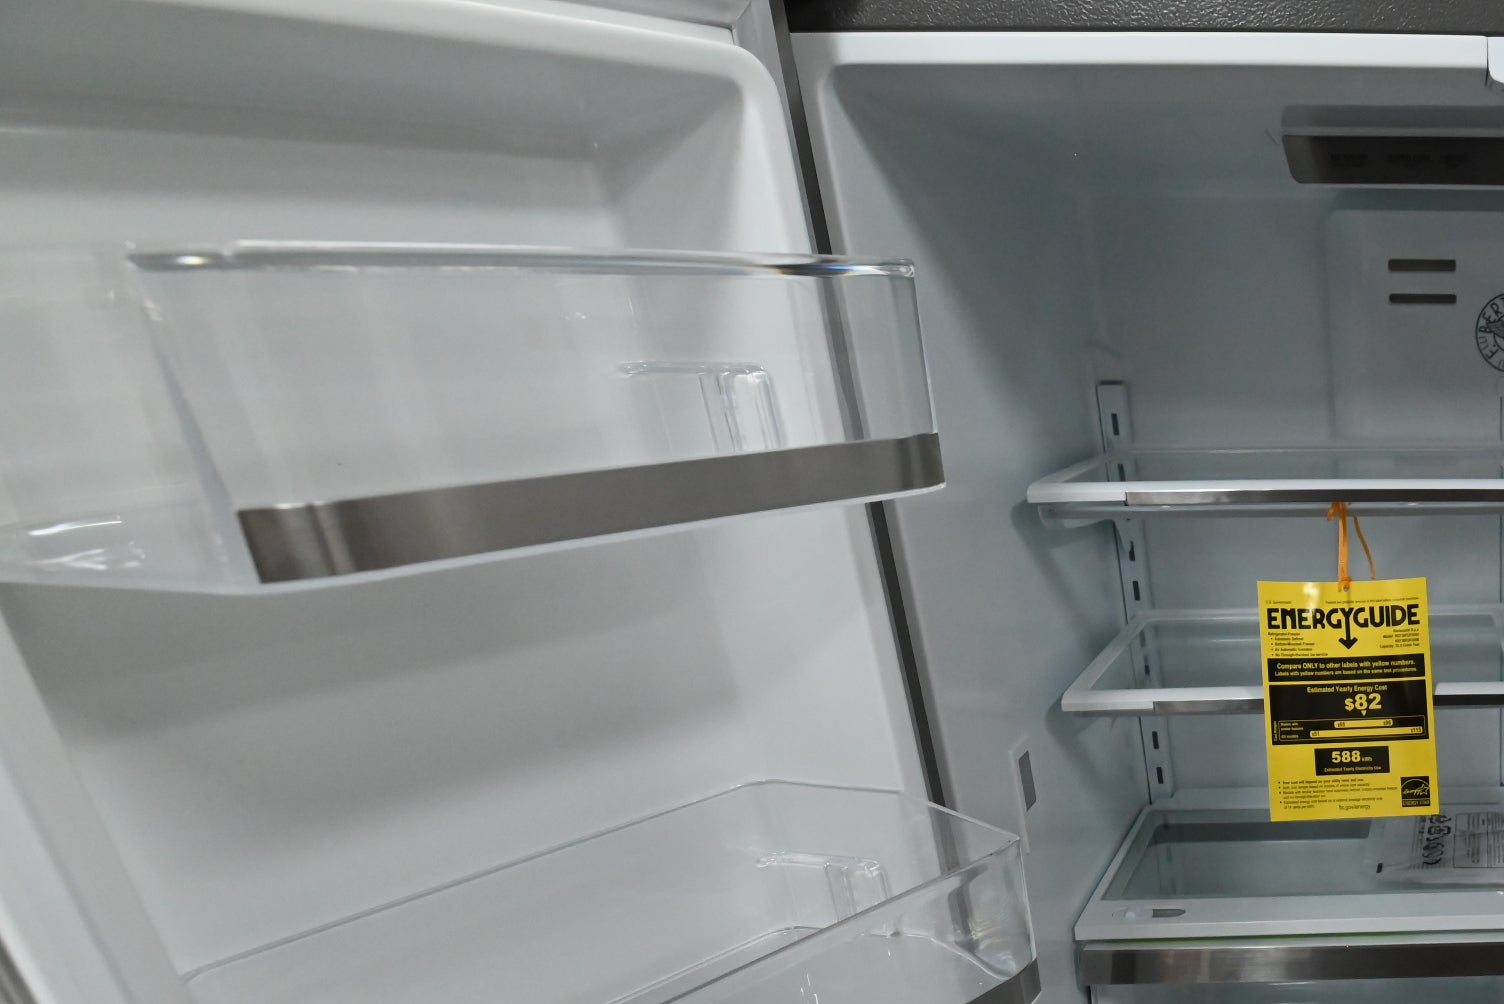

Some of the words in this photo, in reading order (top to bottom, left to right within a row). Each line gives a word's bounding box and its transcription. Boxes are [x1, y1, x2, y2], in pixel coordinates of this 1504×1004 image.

[1266, 603, 1420, 630] ENERGYGUIDE
[1276, 662, 1302, 670] Compare
[1302, 661, 1318, 669] ONLY
[1319, 661, 1325, 669] to
[1326, 660, 1341, 669] other
[1341, 660, 1359, 669] labels
[1359, 659, 1371, 668] with
[1371, 658, 1390, 668] yellow
[1335, 685, 1352, 693] Yearly
[1353, 684, 1374, 693] Energy
[1344, 692, 1382, 711] $82
[1331, 750, 1361, 763] 588
